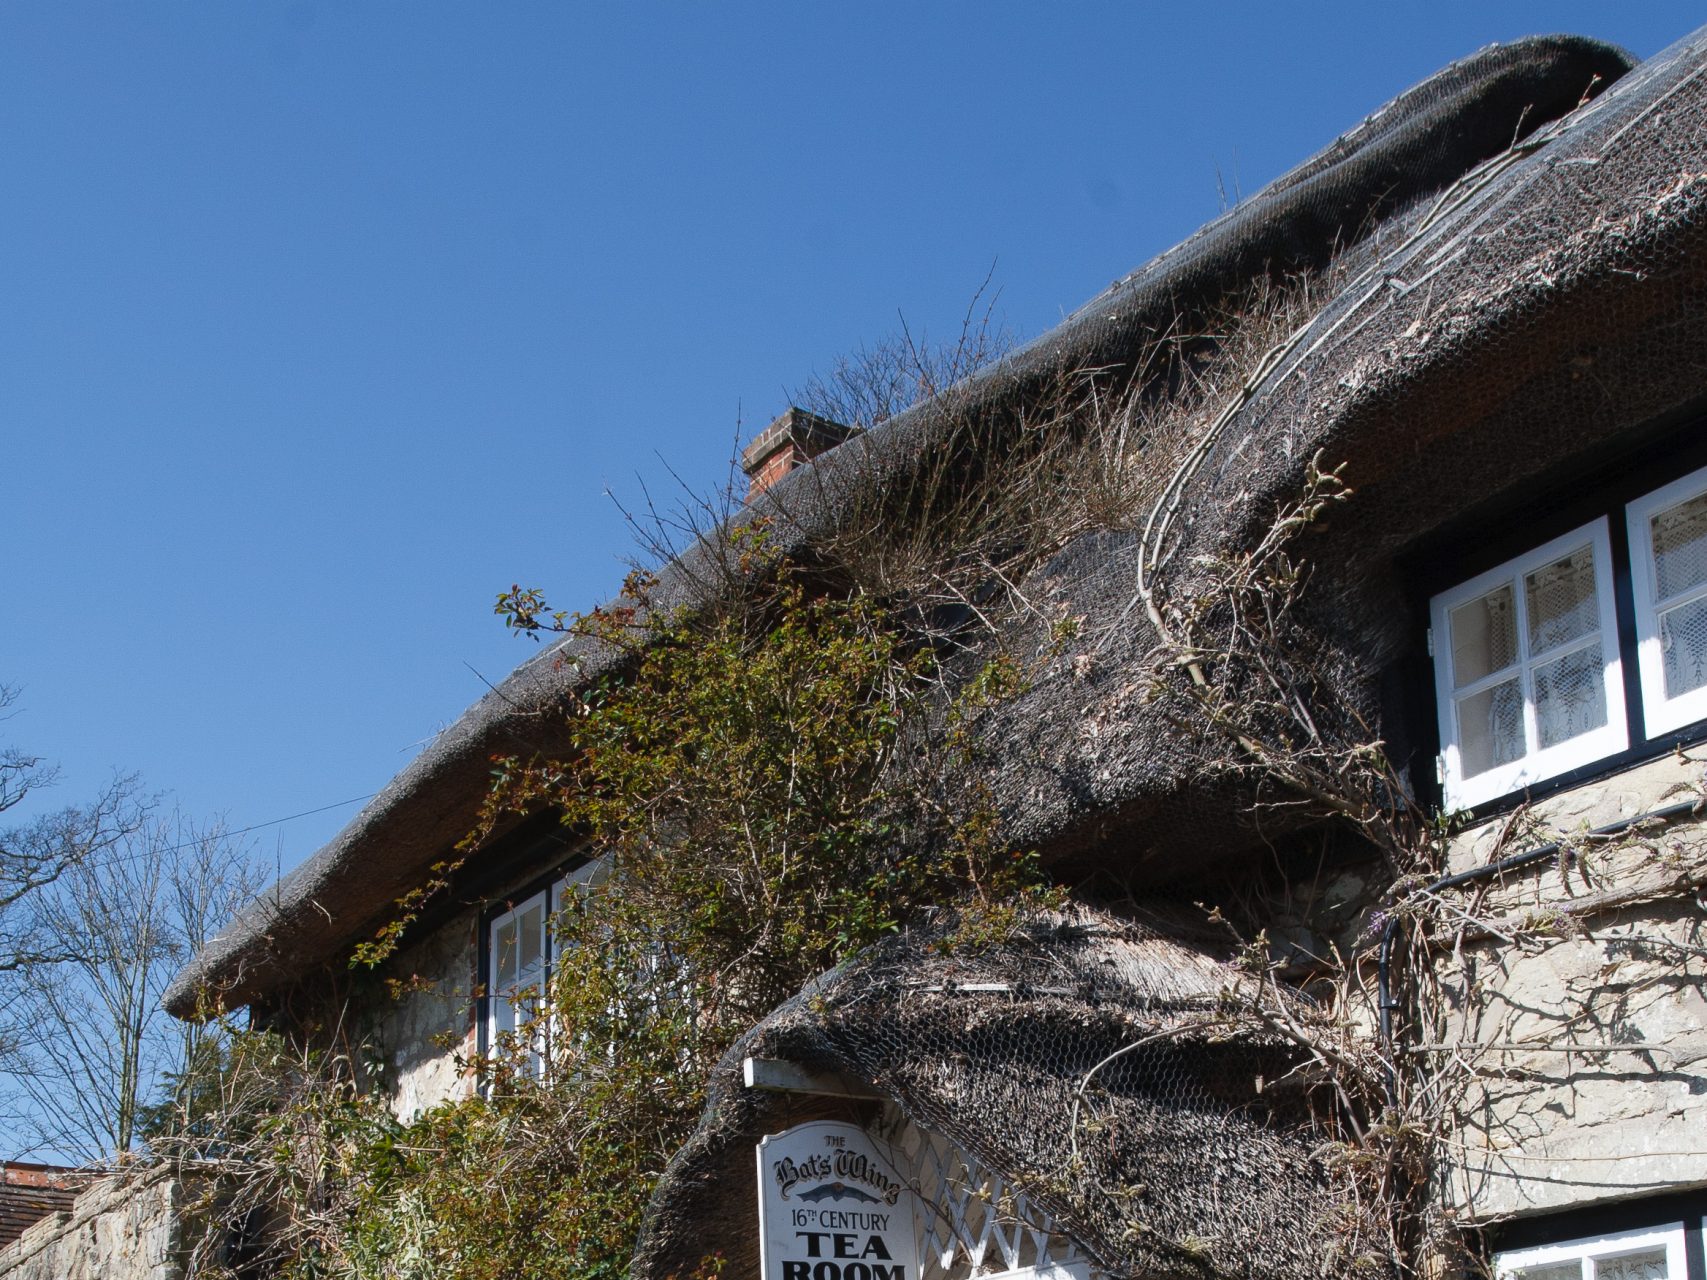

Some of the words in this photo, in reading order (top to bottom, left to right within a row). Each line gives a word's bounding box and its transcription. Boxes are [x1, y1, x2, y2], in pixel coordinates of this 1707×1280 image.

[825, 1135, 846, 1147] THE
[773, 1153, 831, 1200] Bat's
[835, 1149, 900, 1206] Wing
[820, 1210, 890, 1231] CENTURY
[796, 1232, 893, 1260] TEA
